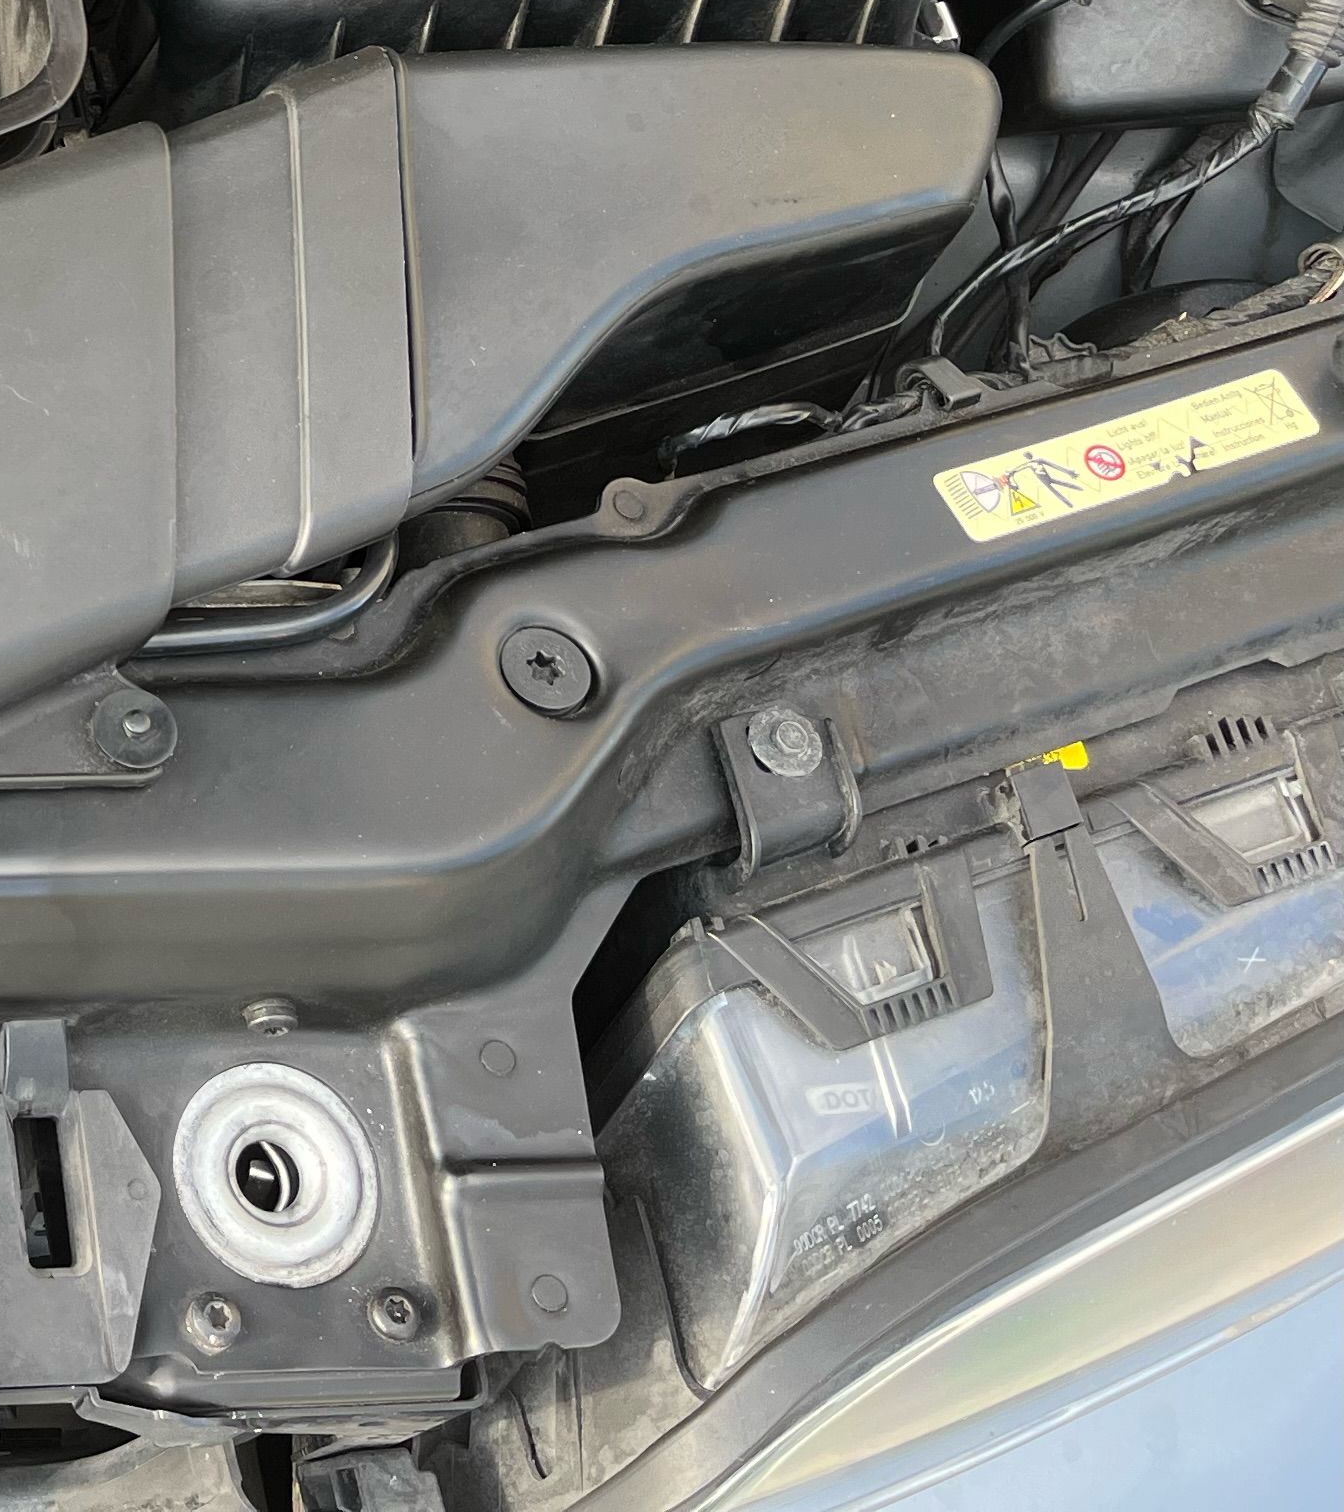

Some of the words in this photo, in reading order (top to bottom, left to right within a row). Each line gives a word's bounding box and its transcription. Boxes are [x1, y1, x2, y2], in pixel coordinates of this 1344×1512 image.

[1212, 417, 1266, 437] Instrucciones
[1221, 433, 1266, 453] Instruction
[825, 1089, 872, 1111] DOT
